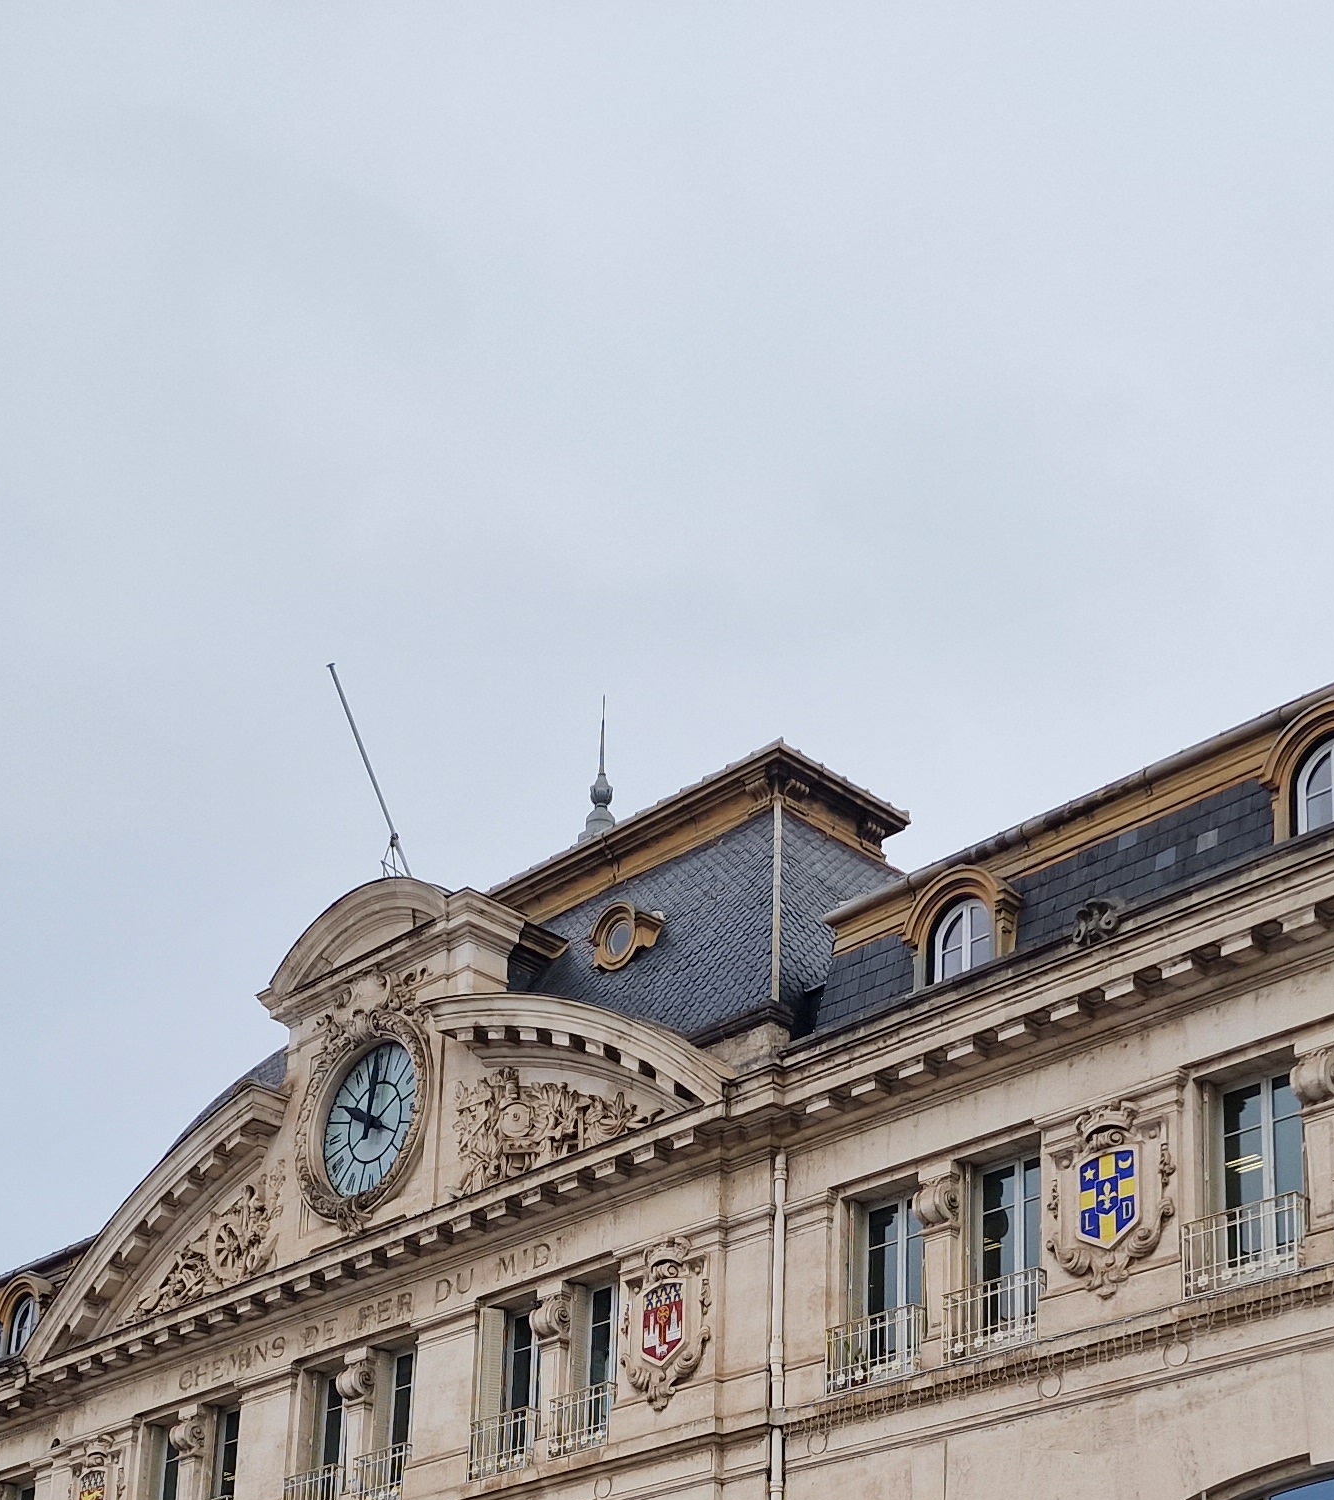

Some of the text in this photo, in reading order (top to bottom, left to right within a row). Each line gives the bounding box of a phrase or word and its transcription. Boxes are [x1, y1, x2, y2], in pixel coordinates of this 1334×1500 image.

[178, 1335, 286, 1391] CHEMINS
[304, 1317, 339, 1350] DE
[434, 1267, 475, 1308] DU
